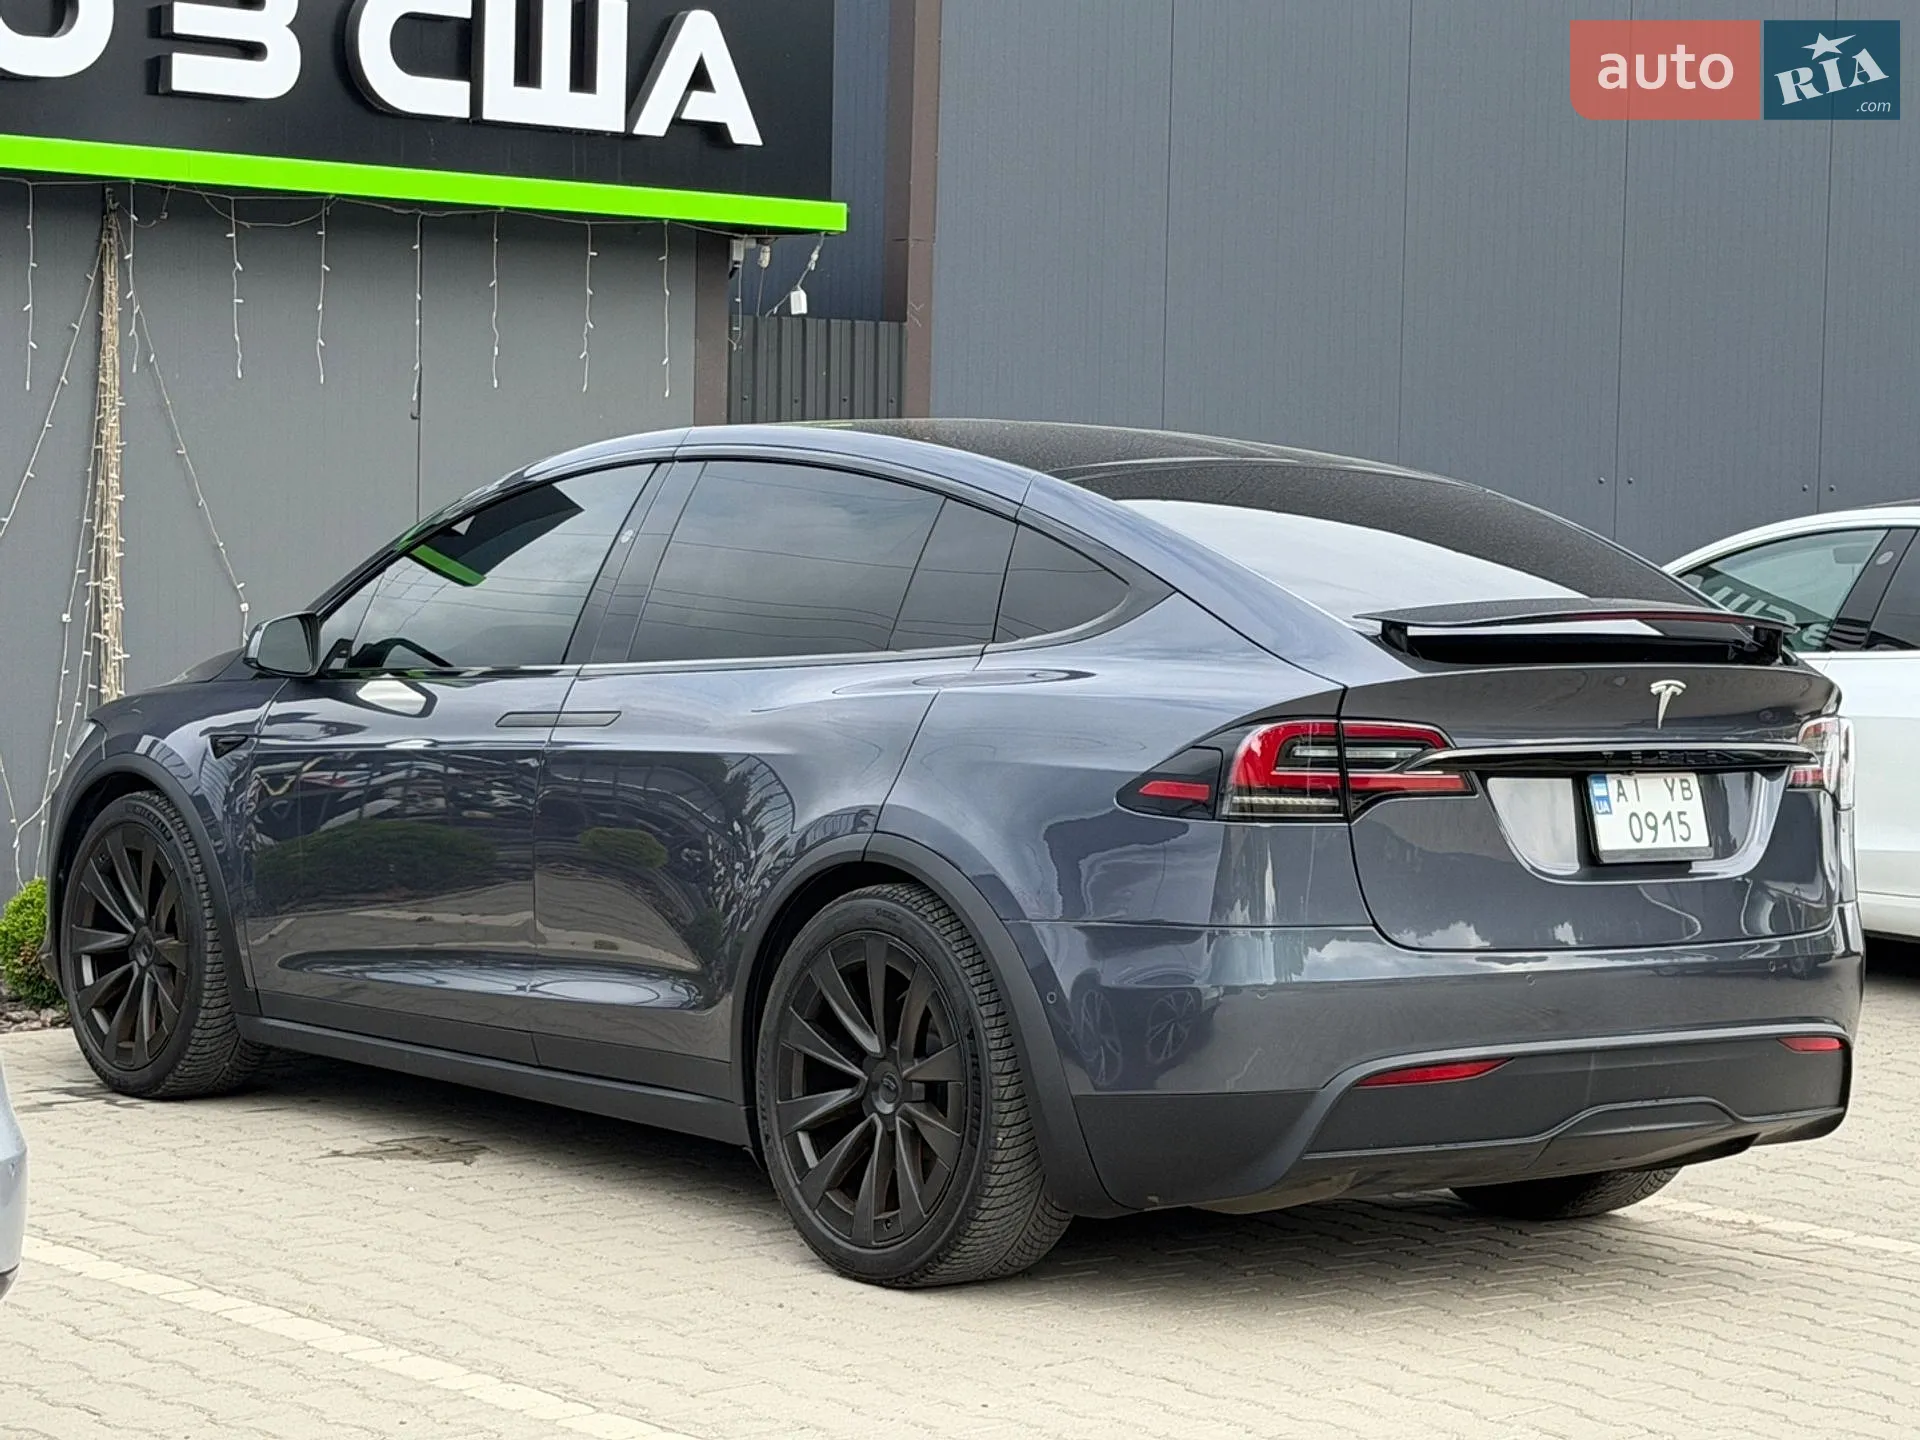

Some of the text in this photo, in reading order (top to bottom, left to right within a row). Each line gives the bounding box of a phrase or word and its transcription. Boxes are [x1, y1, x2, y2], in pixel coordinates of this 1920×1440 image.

[1616, 778, 1694, 802] AI YB
[1628, 810, 1692, 844] 0915
